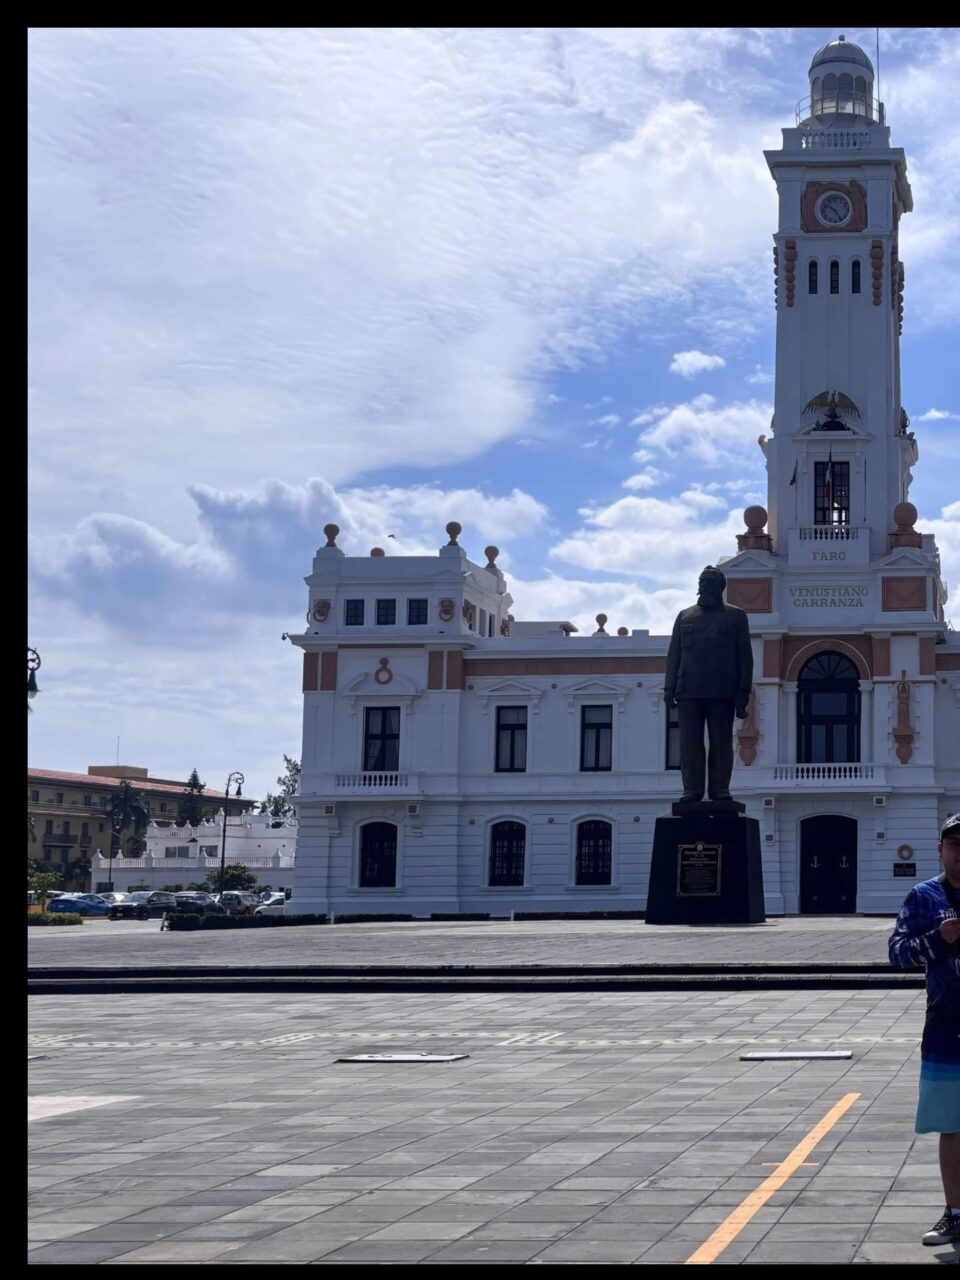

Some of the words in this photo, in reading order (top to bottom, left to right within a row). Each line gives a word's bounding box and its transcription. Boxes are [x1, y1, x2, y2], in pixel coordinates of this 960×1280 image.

[812, 552, 846, 561] FARO
[790, 587, 869, 597] VENUSTIANO
[793, 598, 864, 608] CARRANZA
